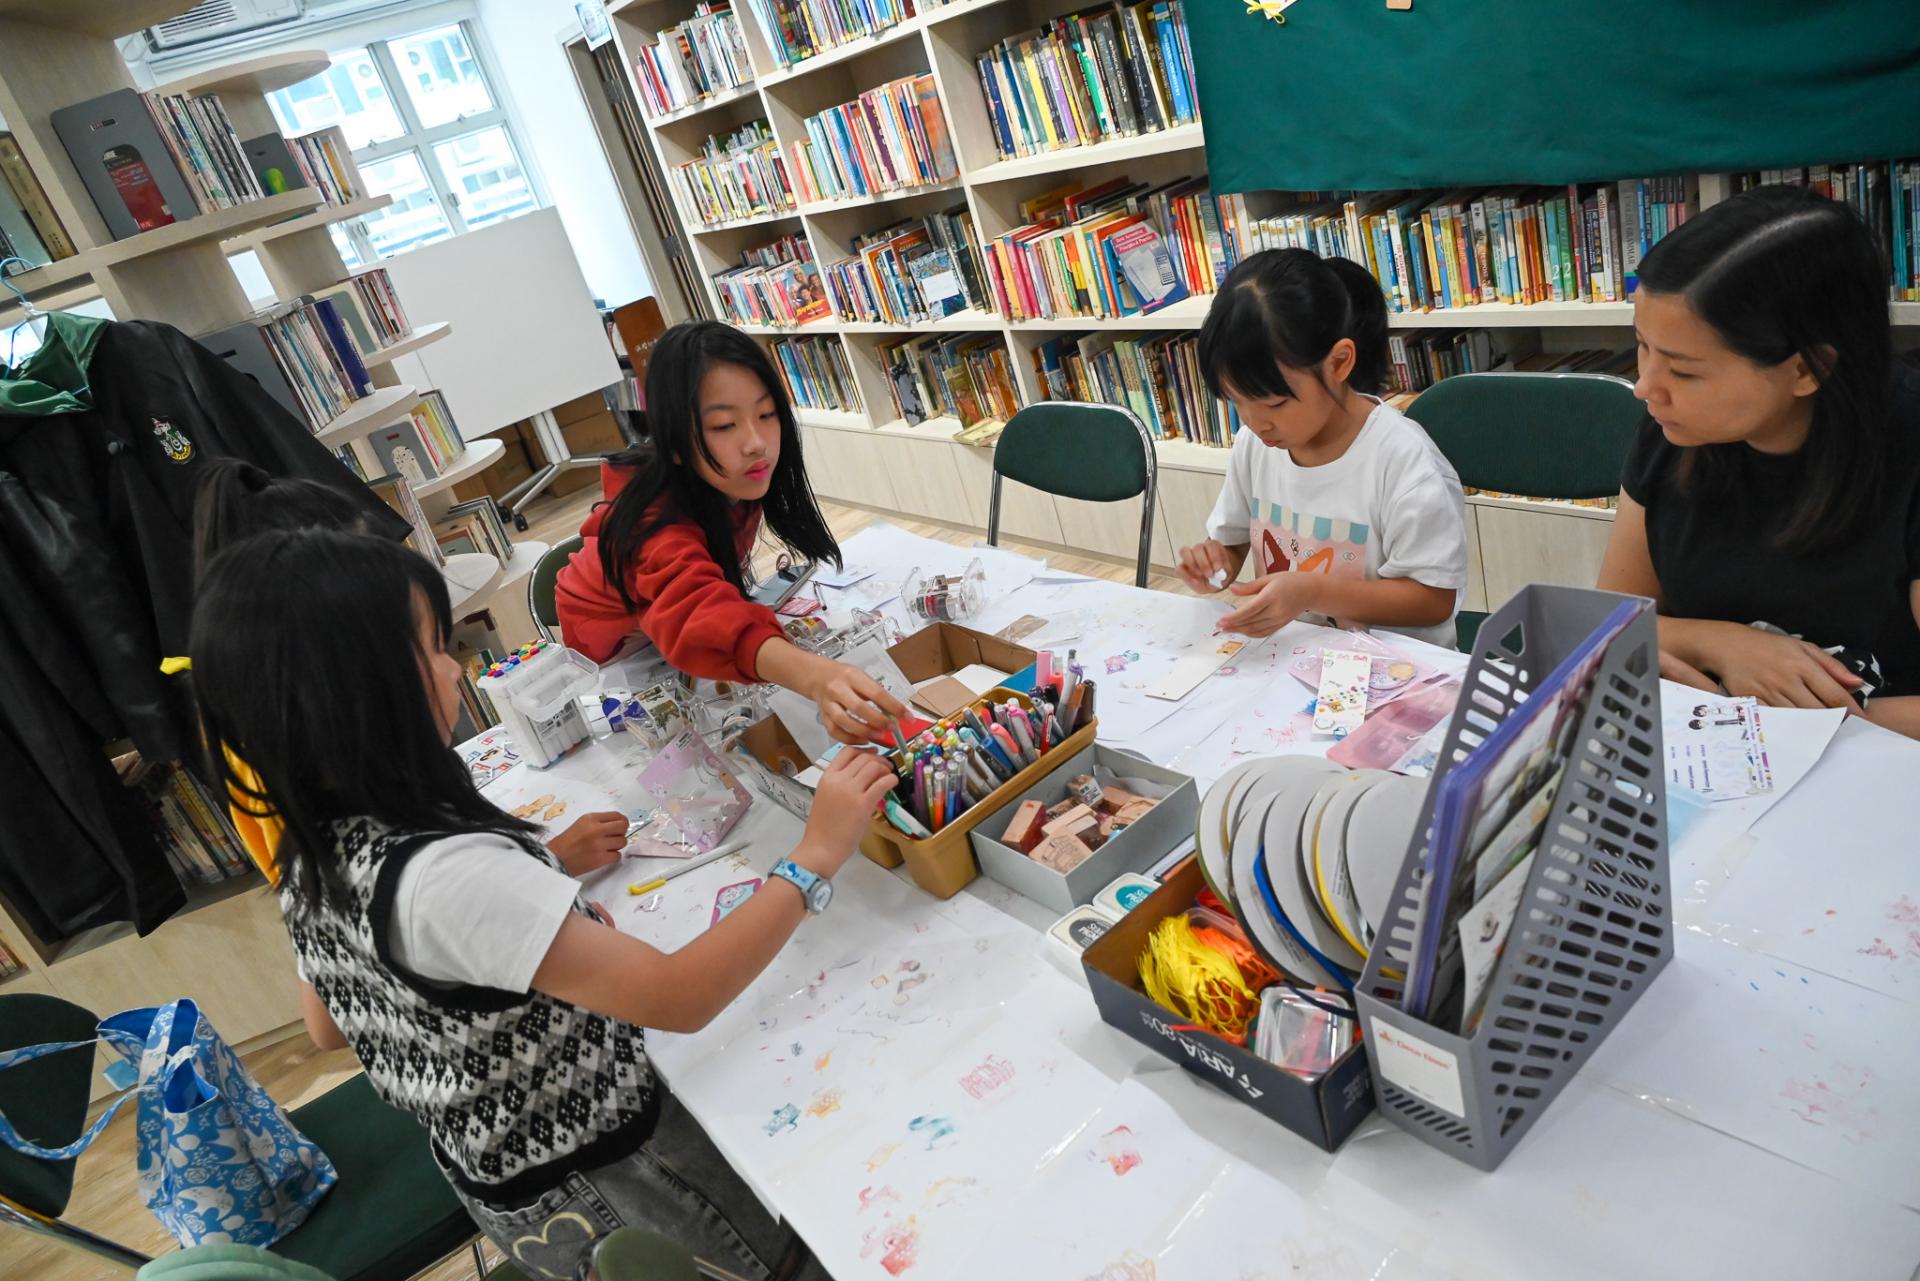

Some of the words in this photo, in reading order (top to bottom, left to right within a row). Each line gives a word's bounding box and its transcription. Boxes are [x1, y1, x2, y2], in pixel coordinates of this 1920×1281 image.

[1597, 193, 1609, 220] Collins
[1623, 195, 1634, 226] ENGLISH
[1624, 227, 1636, 265] GRAMMAR
[1550, 264, 1561, 280] 2
[1562, 262, 1572, 278] 2
[1176, 1037, 1235, 1079] ARIA
